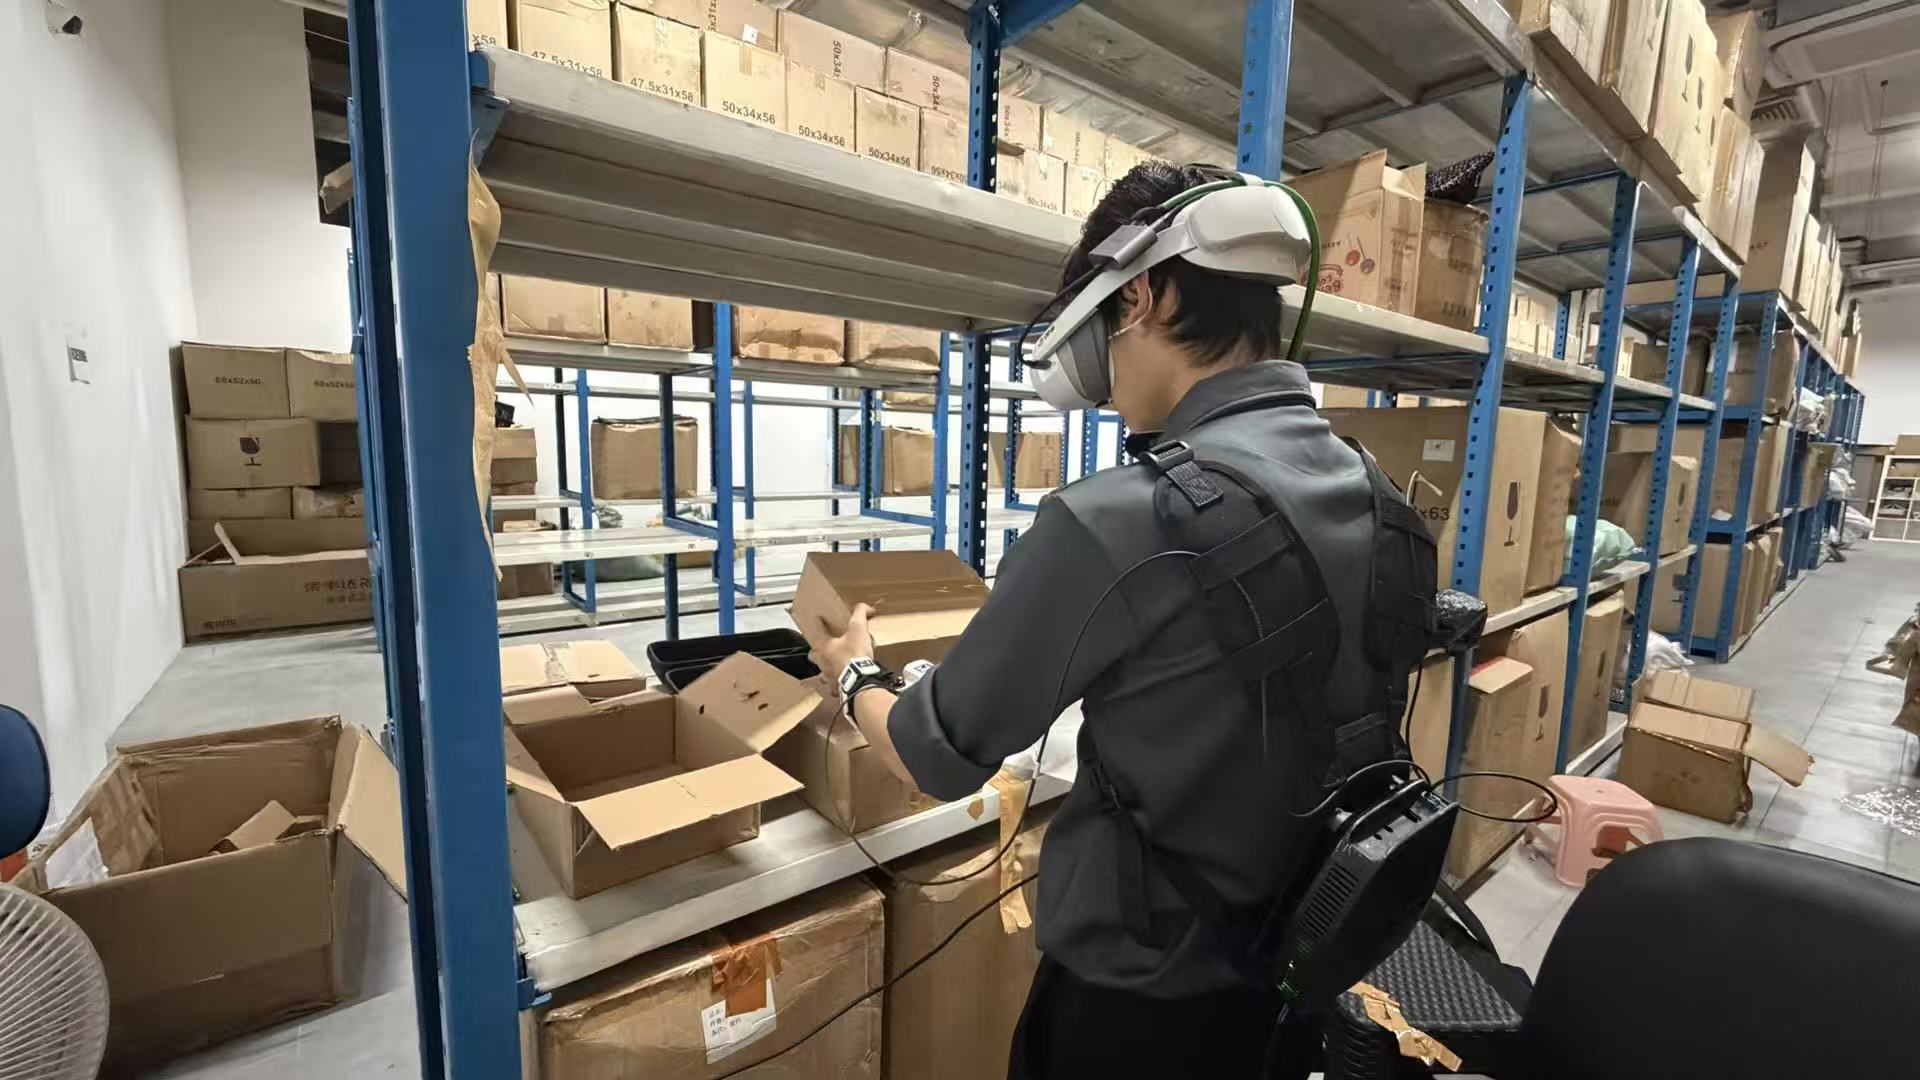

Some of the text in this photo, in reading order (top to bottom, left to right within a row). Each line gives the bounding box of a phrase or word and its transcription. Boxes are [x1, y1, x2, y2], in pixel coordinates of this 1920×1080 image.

[630, 77, 694, 102] 47.5x31x58
[722, 101, 776, 125] 50x34x56
[798, 125, 846, 147] 50x34x56
[868, 147, 911, 167] 50x34x56
